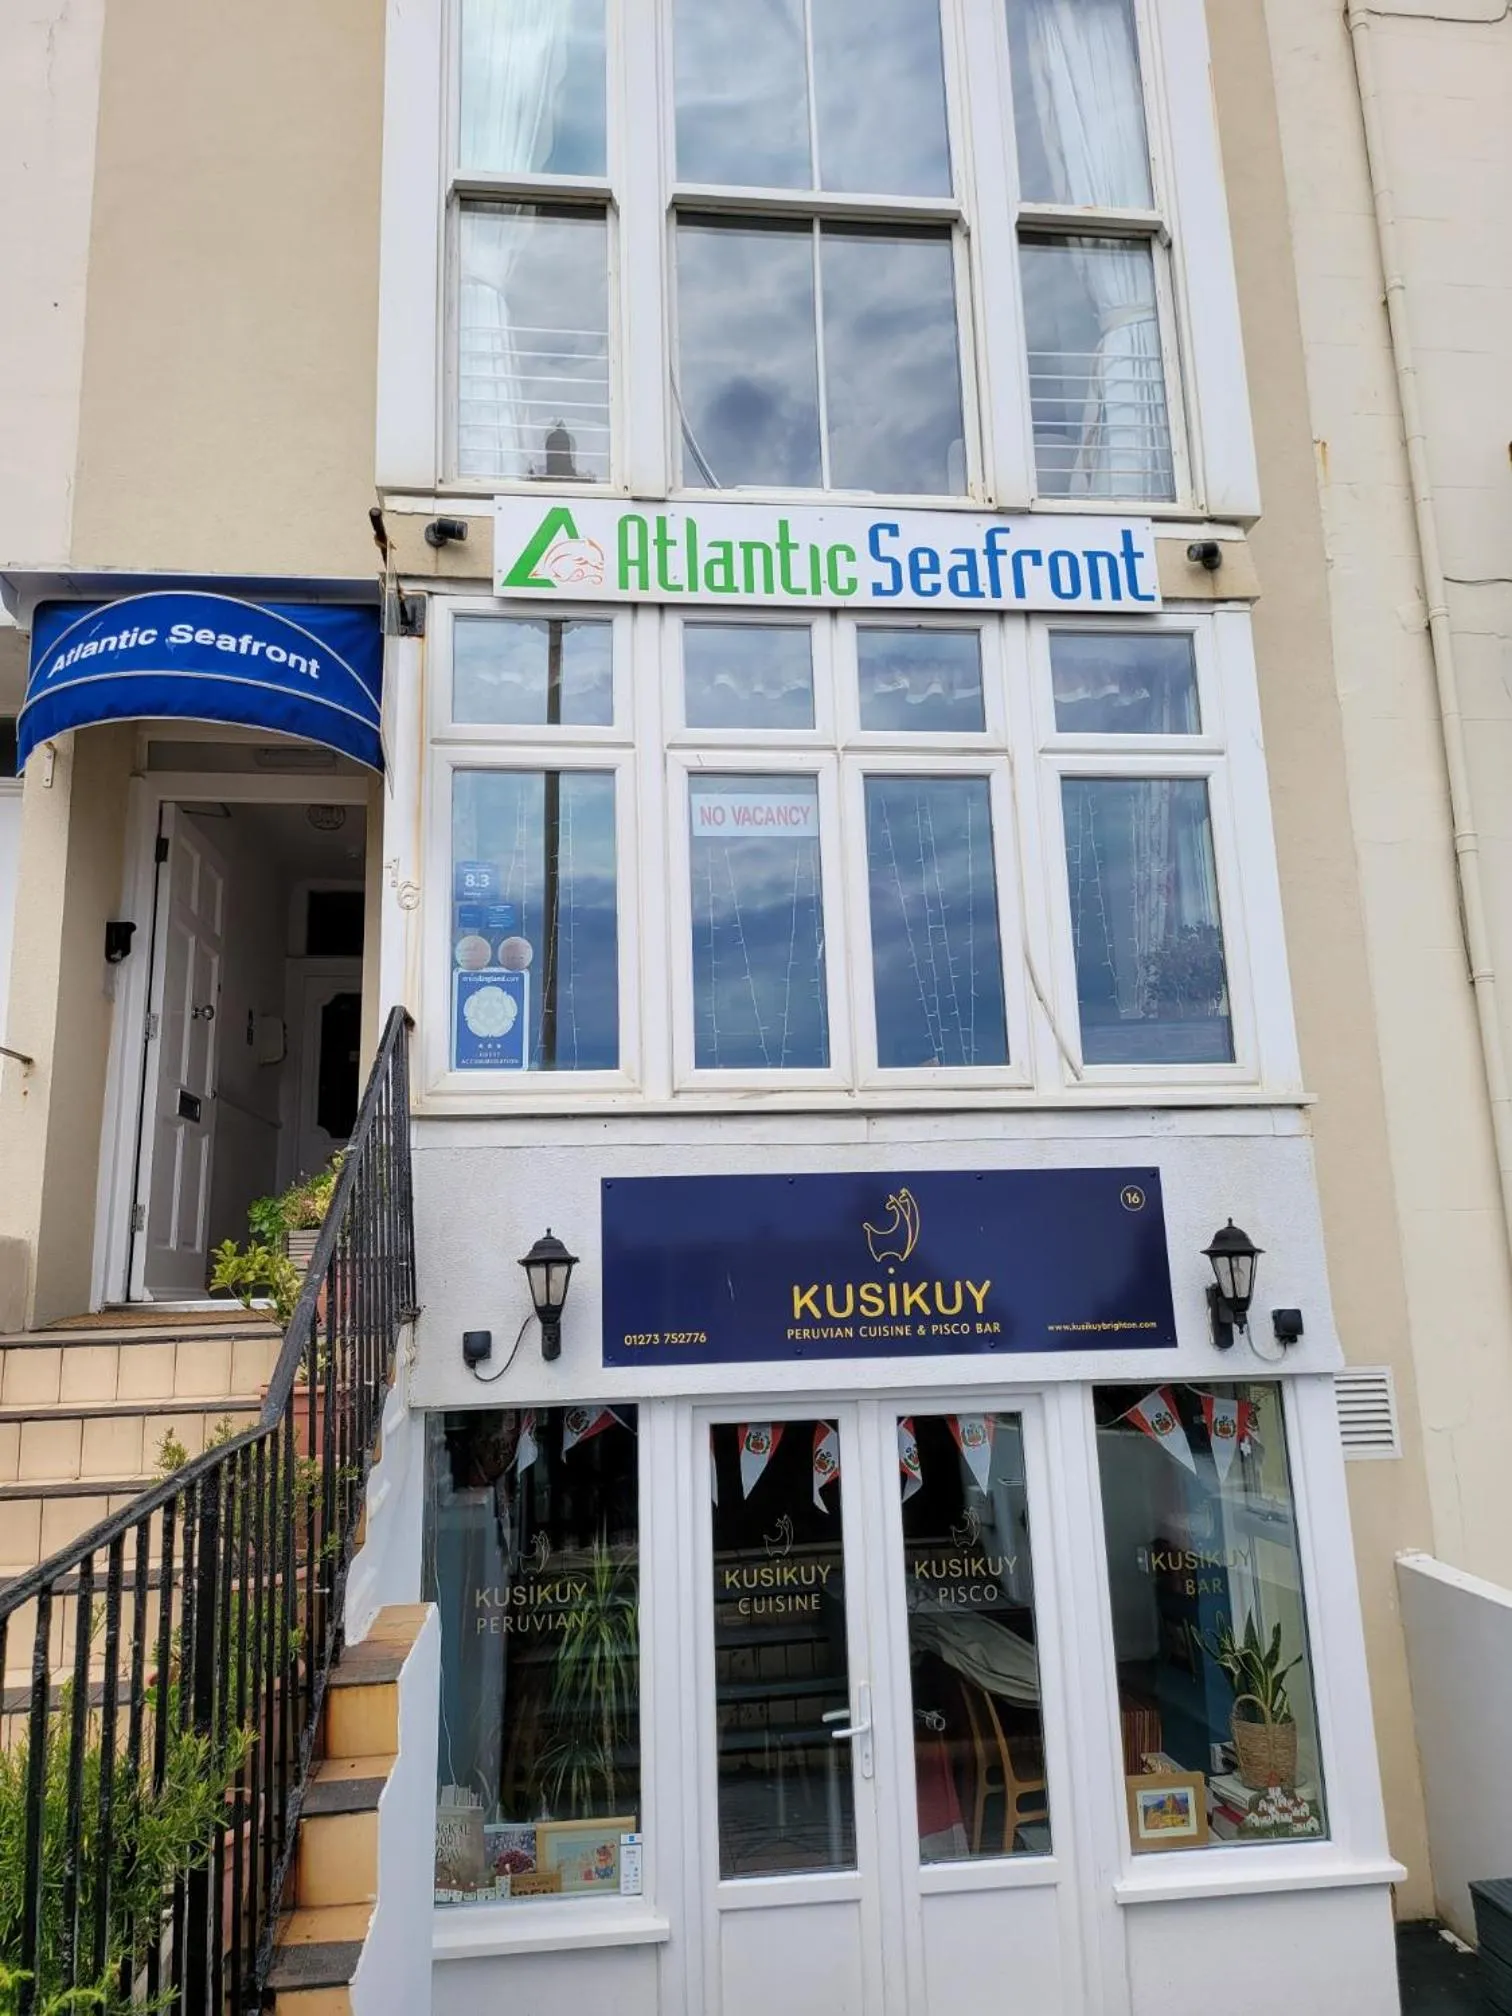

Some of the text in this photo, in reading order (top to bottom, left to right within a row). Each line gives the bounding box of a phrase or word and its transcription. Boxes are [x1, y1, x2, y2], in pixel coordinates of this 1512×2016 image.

[618, 514, 1156, 603] Atlantic Seafront
[47, 624, 321, 680] Atlantic Seafront
[700, 805, 811, 826] NO VACANCY
[464, 873, 490, 888] 8.3
[1125, 1192, 1140, 1204] 16
[624, 1331, 707, 1346] 01273 752776
[786, 1321, 1001, 1340] PERUVIAN CUISINE & PISCO BAR
[938, 1584, 999, 1604] PISCO
[1185, 1577, 1224, 1596] BAR
[738, 1593, 822, 1616] CUISINE
[476, 1611, 588, 1635] PERUVIAN
